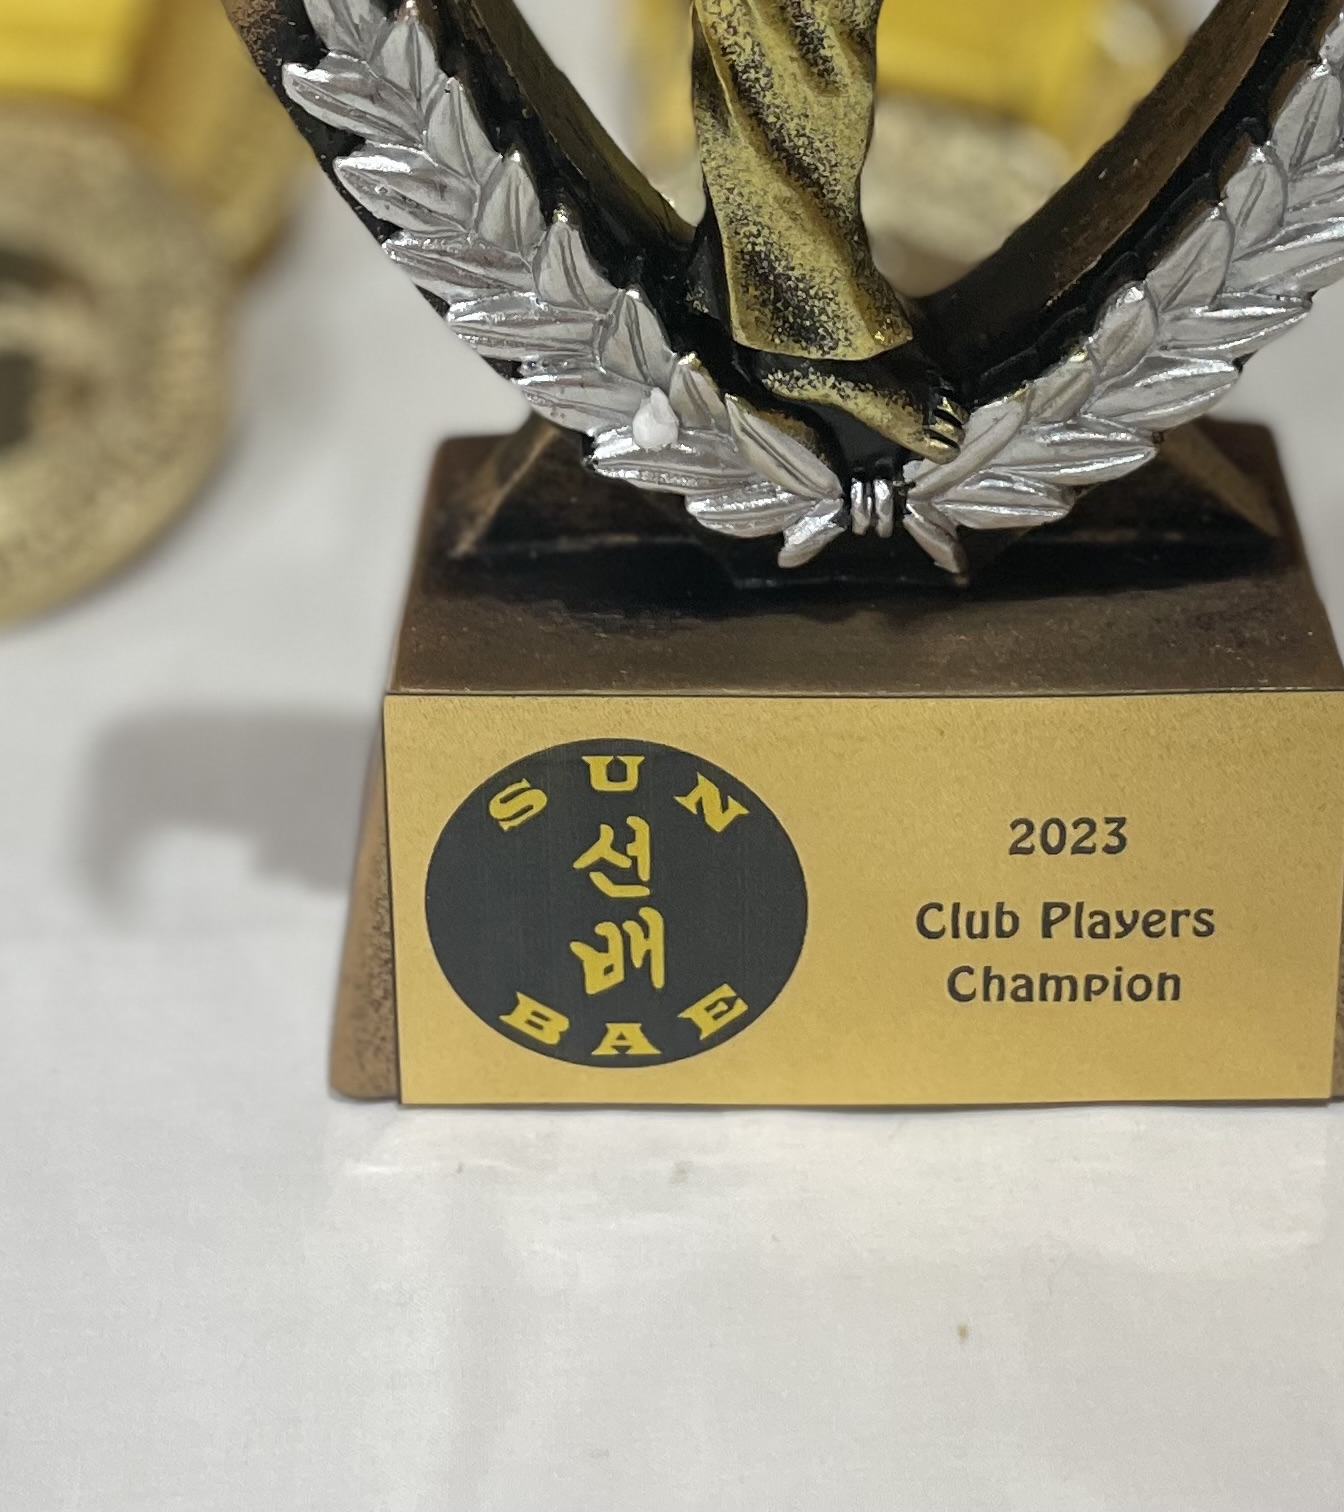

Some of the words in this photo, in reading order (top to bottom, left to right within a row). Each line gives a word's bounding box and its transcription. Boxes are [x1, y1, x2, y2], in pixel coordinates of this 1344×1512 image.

[488, 755, 749, 833] SUN
[1008, 816, 1128, 856] 2023
[569, 815, 665, 996] 선배
[915, 901, 1020, 939] Club
[1041, 901, 1215, 939] Players
[947, 965, 1181, 1002] Champion
[499, 983, 749, 1056] BAE
